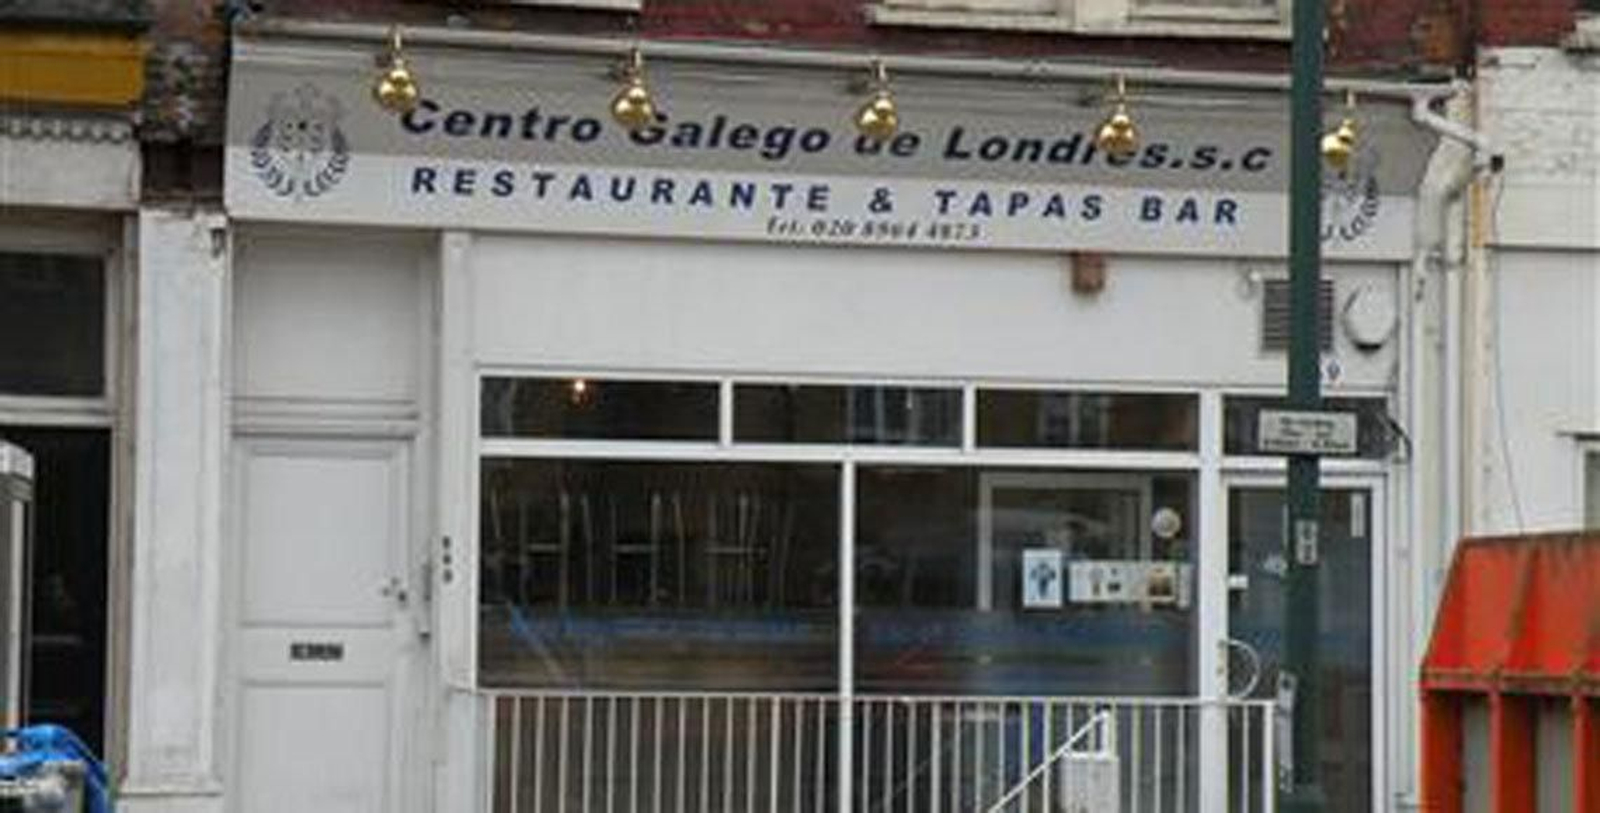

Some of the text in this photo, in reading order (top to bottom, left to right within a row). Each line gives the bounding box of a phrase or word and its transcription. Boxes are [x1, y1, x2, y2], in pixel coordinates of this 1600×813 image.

[402, 99, 602, 142] Centro
[629, 113, 831, 160] Galego
[412, 167, 1239, 224] RESTAURANTE & TAPAS BAR
